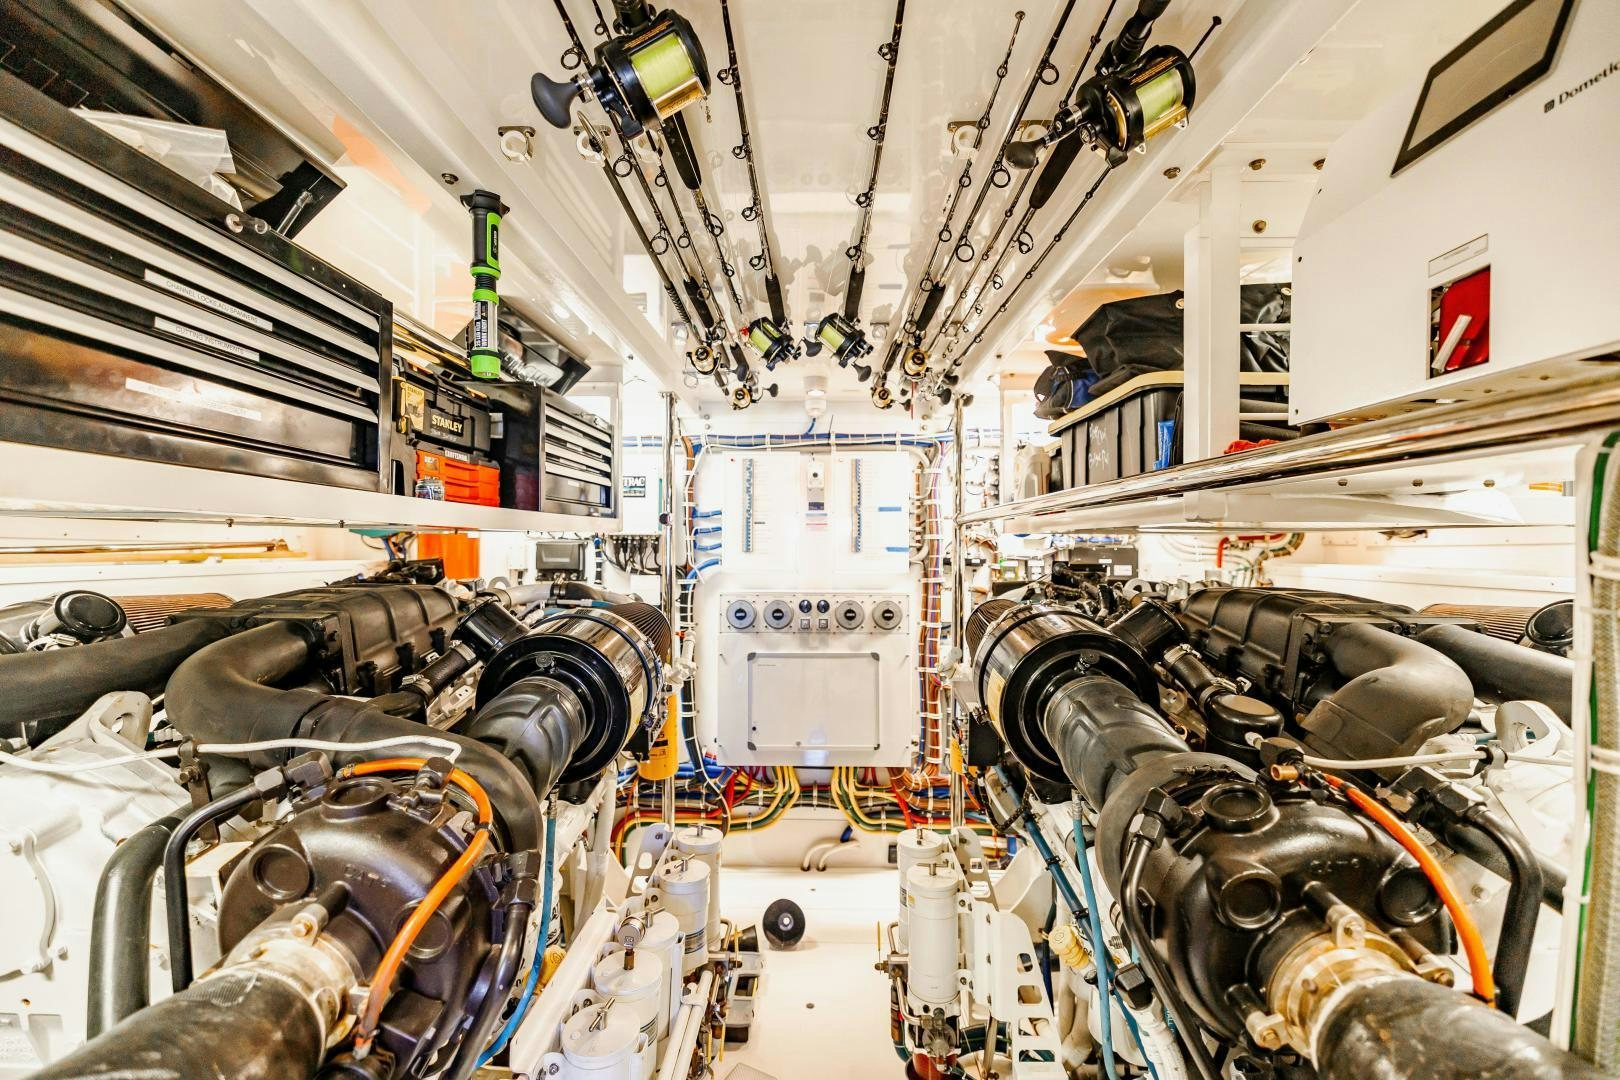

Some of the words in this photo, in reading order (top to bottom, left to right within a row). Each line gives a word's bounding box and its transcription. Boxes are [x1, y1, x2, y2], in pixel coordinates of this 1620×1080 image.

[1559, 61, 1620, 105] Dometic
[166, 280, 196, 298] CHANNEL
[197, 291, 217, 307] LOCKS
[175, 326, 203, 341] CUTTING
[431, 414, 463, 433] STANLEY
